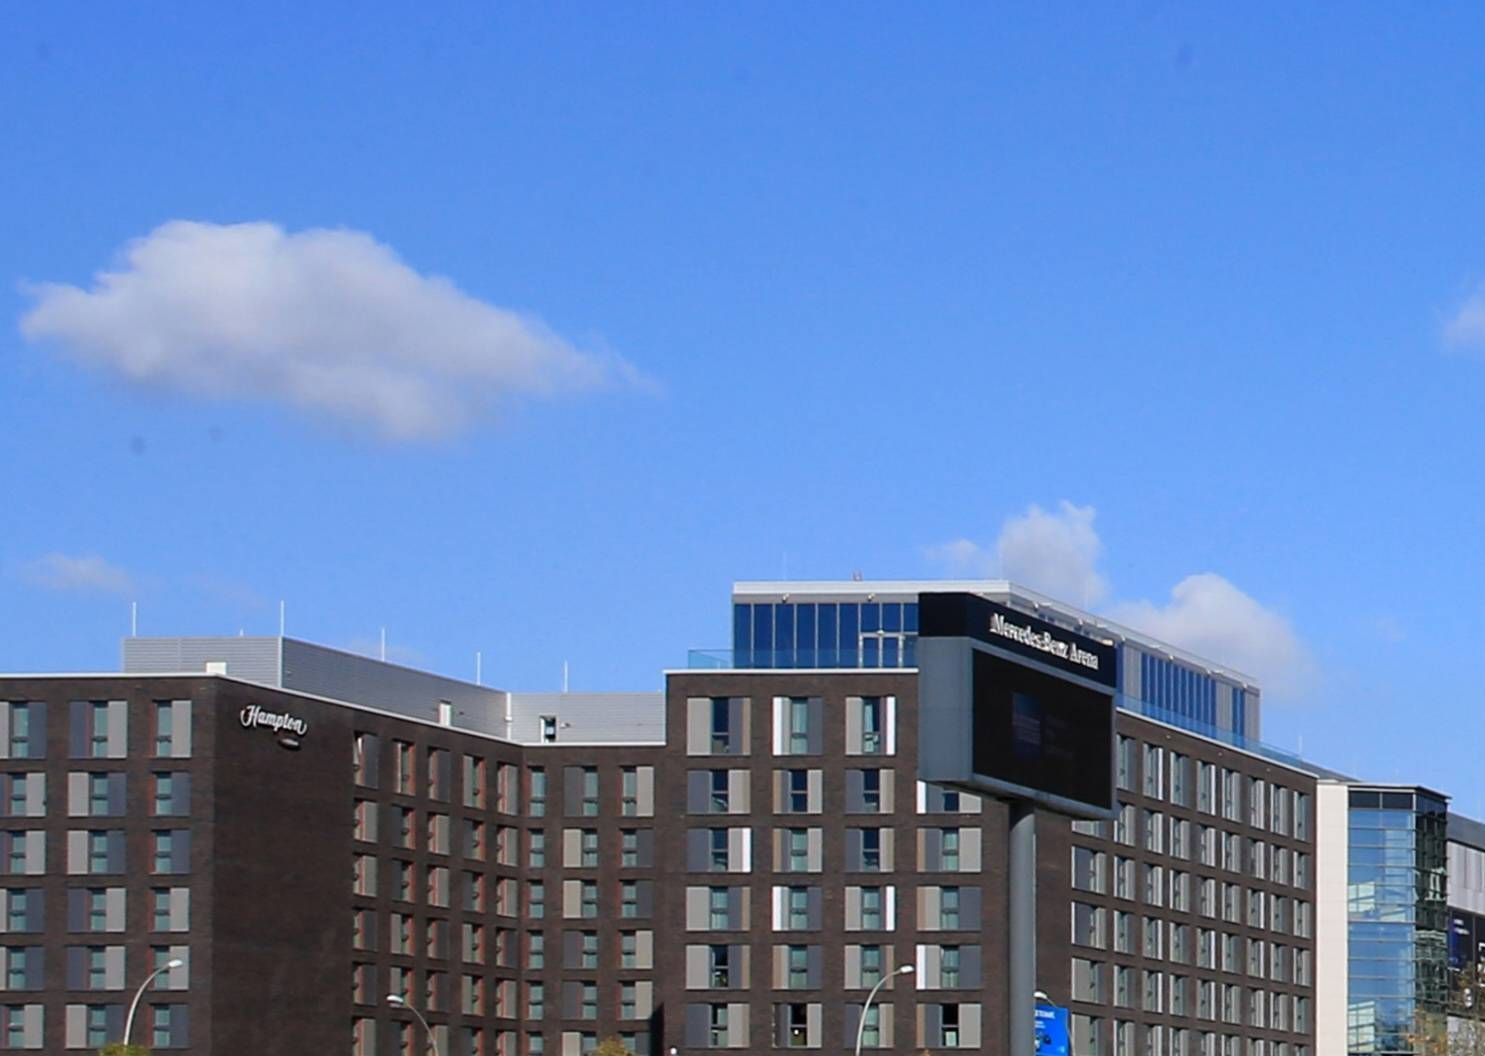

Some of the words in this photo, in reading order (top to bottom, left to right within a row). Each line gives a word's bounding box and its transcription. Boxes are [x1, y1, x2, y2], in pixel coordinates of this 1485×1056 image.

[989, 612, 1069, 659] Mercedes-Benz
[1069, 642, 1099, 671] Arena
[240, 705, 308, 735] Hampton
